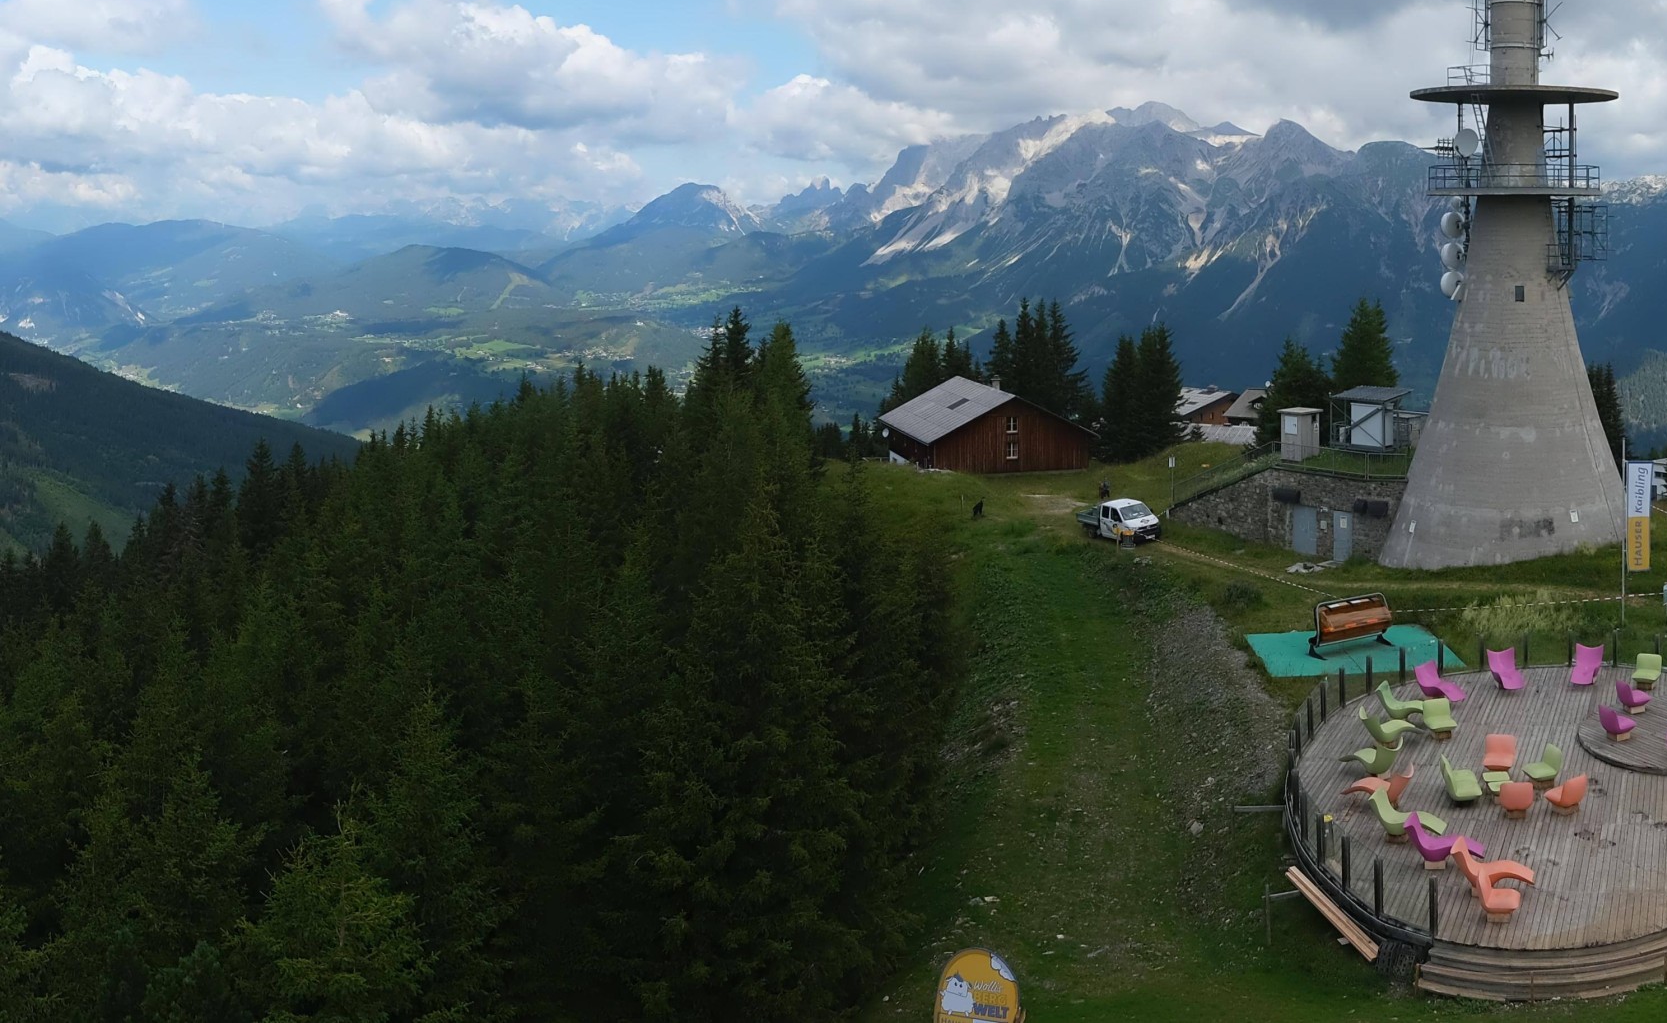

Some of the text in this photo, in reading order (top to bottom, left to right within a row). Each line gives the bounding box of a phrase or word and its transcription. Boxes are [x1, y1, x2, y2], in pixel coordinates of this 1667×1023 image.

[1634, 467, 1648, 566] HAUSER Kaibling
[974, 992, 1007, 1005] BERG
[973, 1003, 1009, 1018] WELT
